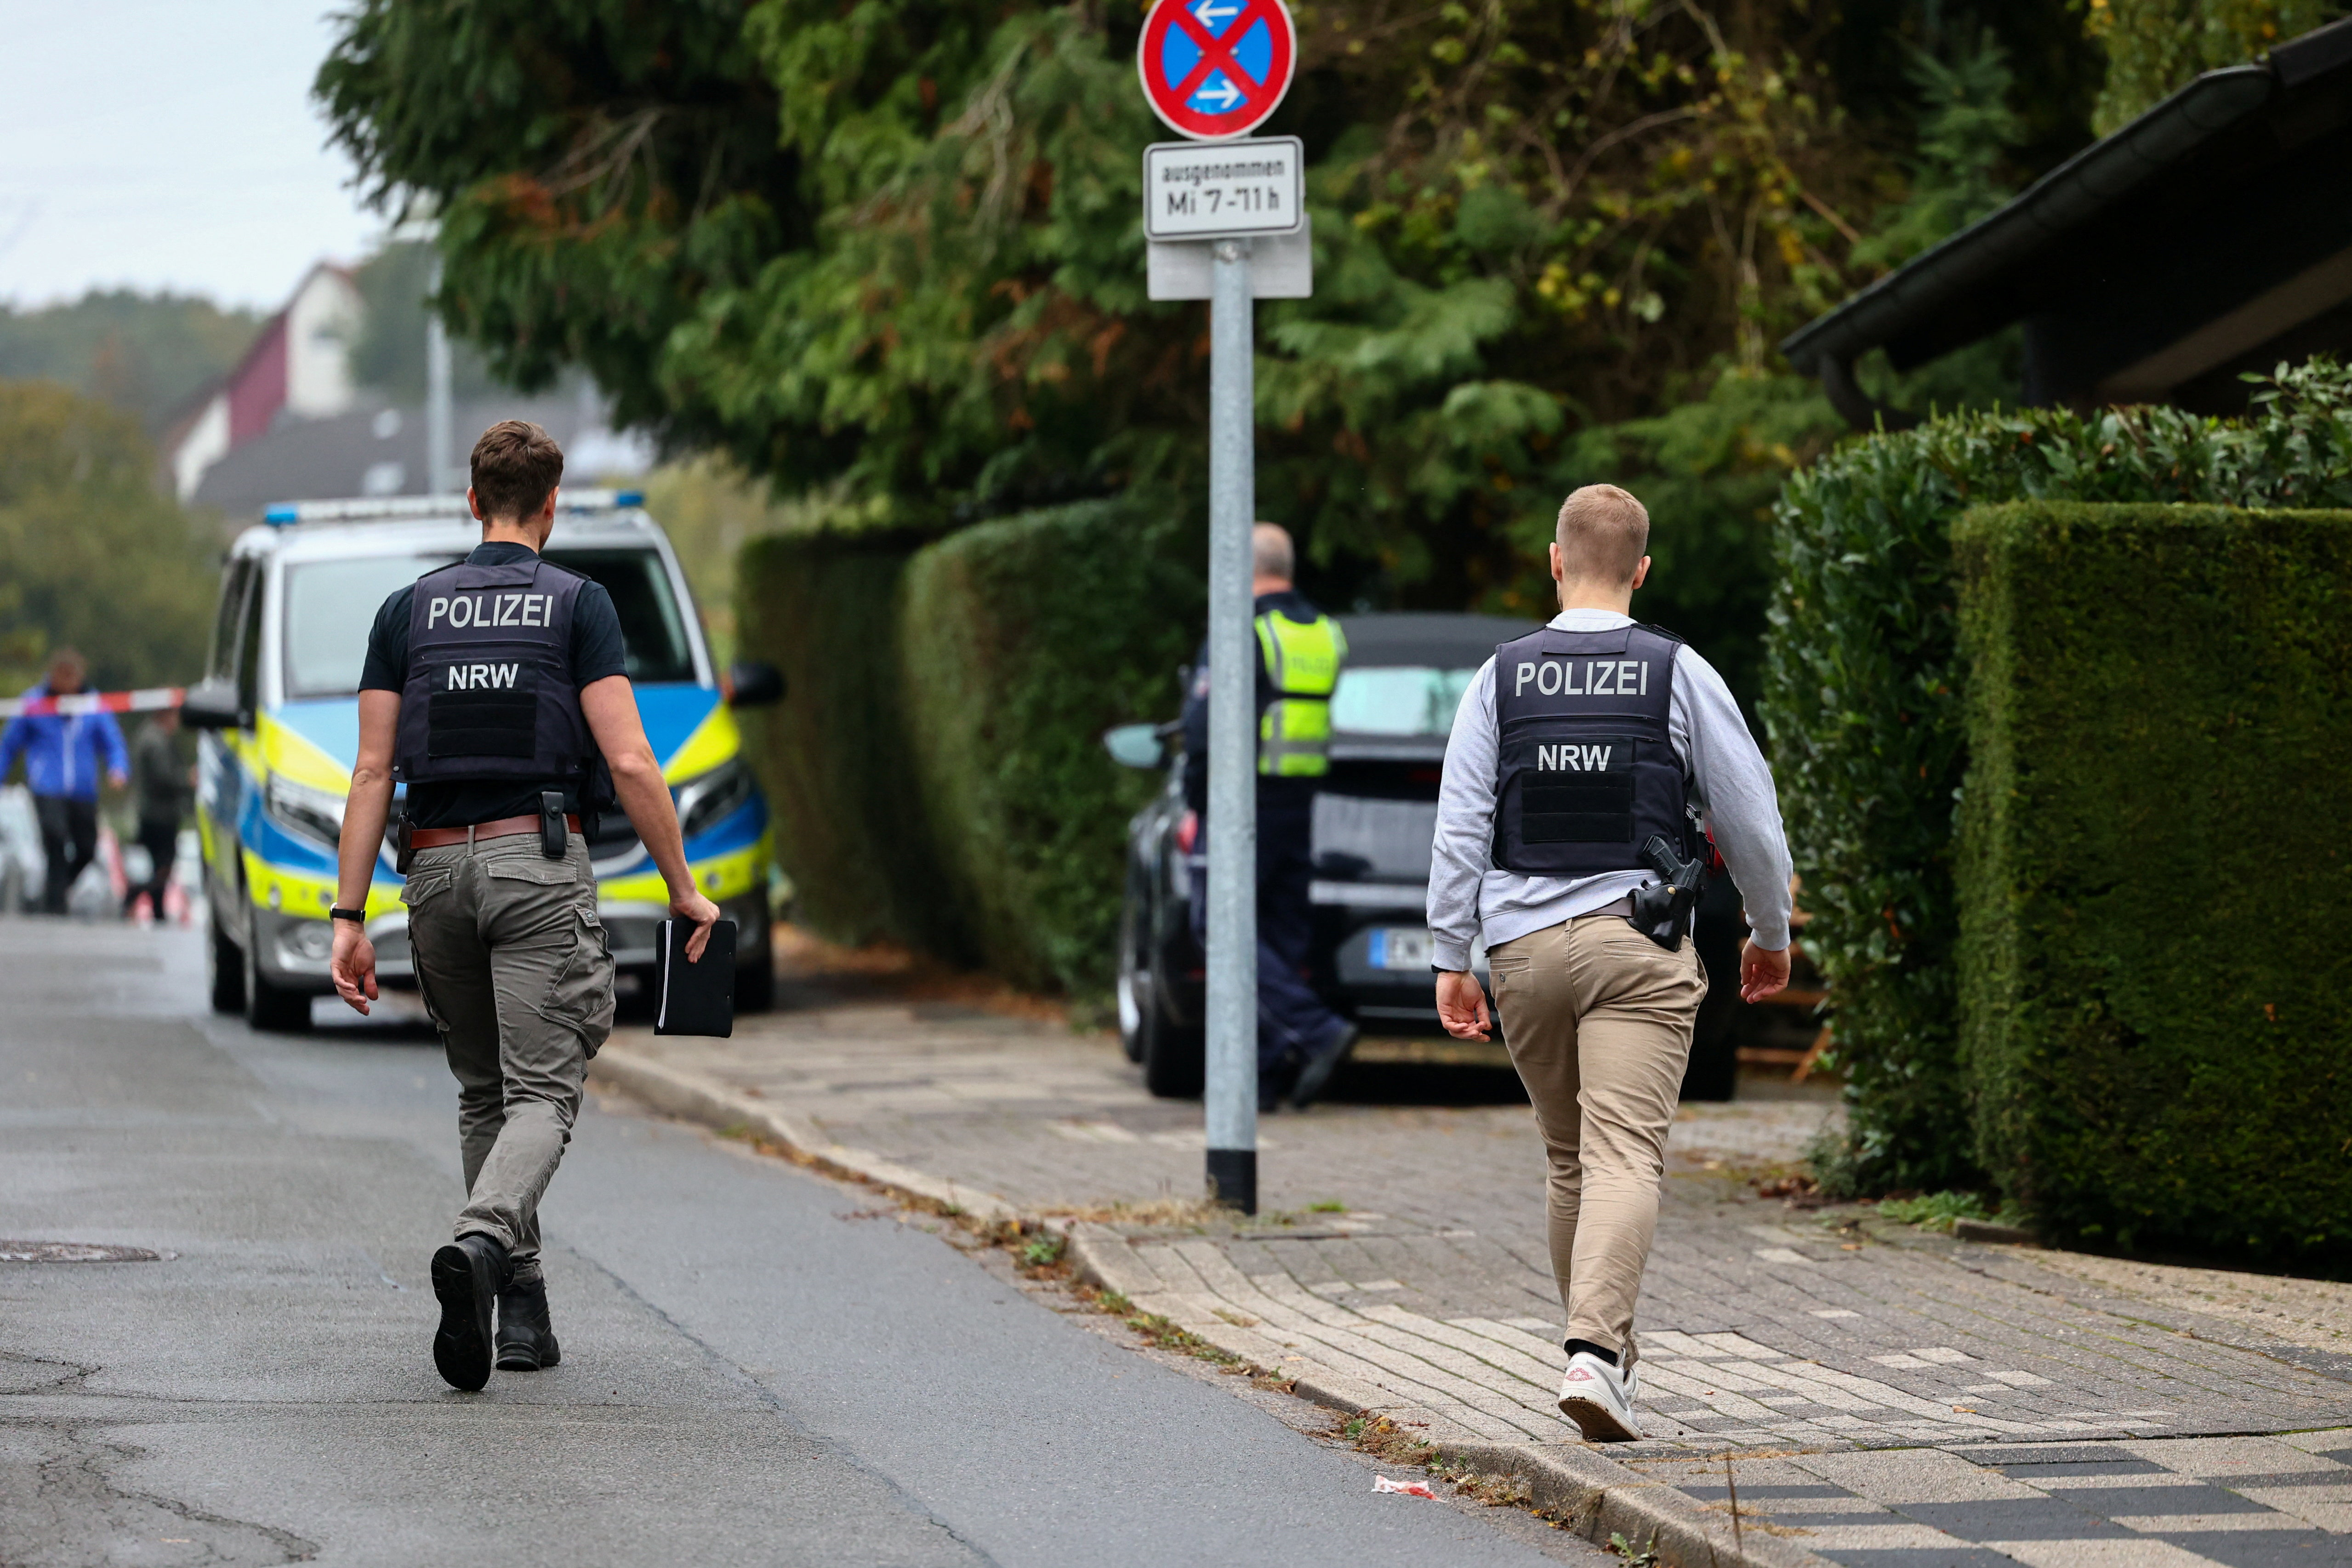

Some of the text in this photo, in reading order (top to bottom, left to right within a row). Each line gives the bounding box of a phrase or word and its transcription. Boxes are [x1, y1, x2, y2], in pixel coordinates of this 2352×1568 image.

[1162, 160, 1285, 186] ausgenommen
[1167, 186, 1280, 215] Mi 7-11 h
[428, 594, 553, 629] POLIZEI
[448, 663, 518, 690] NRW
[1515, 661, 1648, 696] POLIZEI
[1538, 745, 1612, 771] NRW
